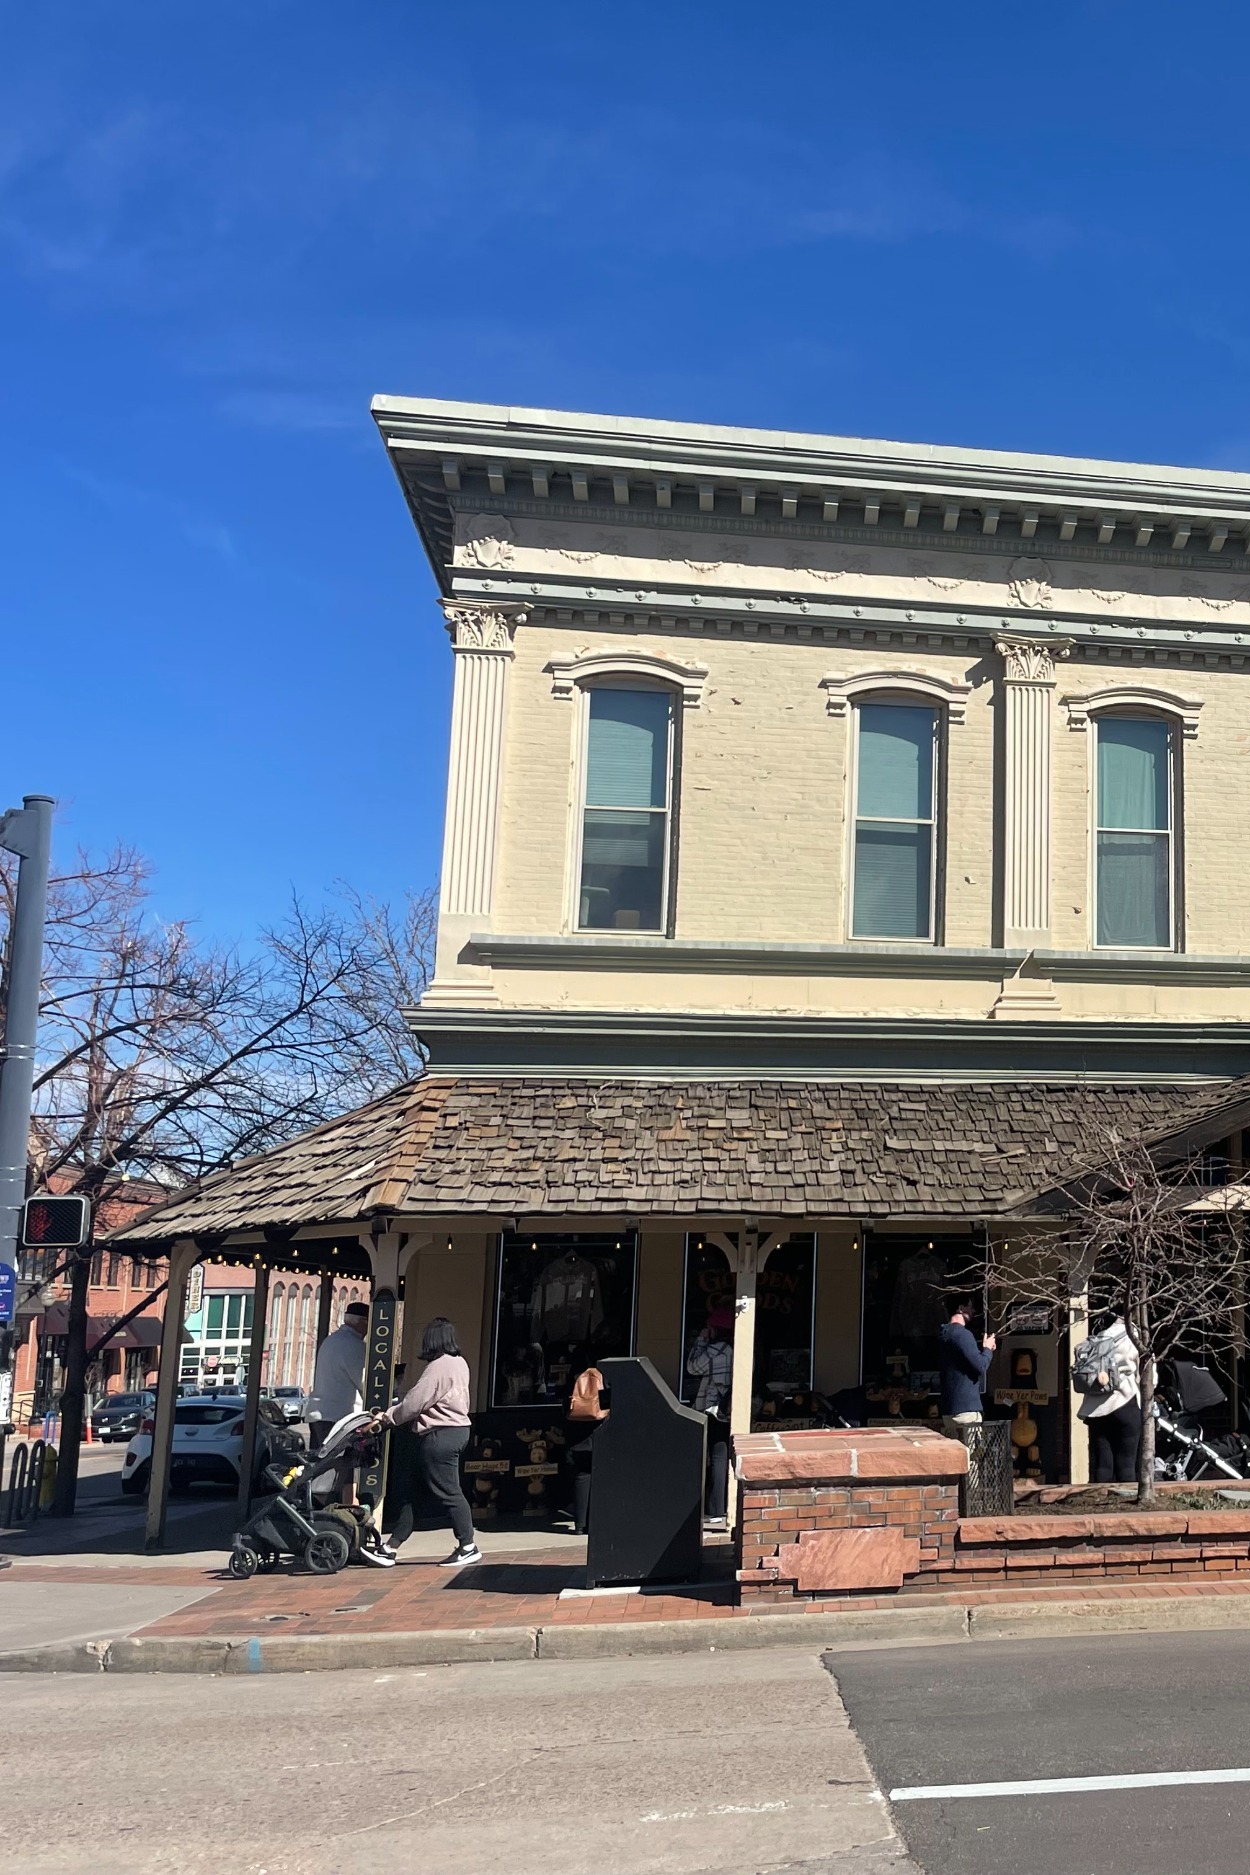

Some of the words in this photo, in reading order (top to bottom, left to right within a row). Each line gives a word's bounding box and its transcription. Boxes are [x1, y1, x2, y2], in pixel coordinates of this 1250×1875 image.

[697, 1269, 800, 1294] GODEN
[706, 1291, 794, 1315] GDS
[373, 1308, 390, 1388] LOCAL
